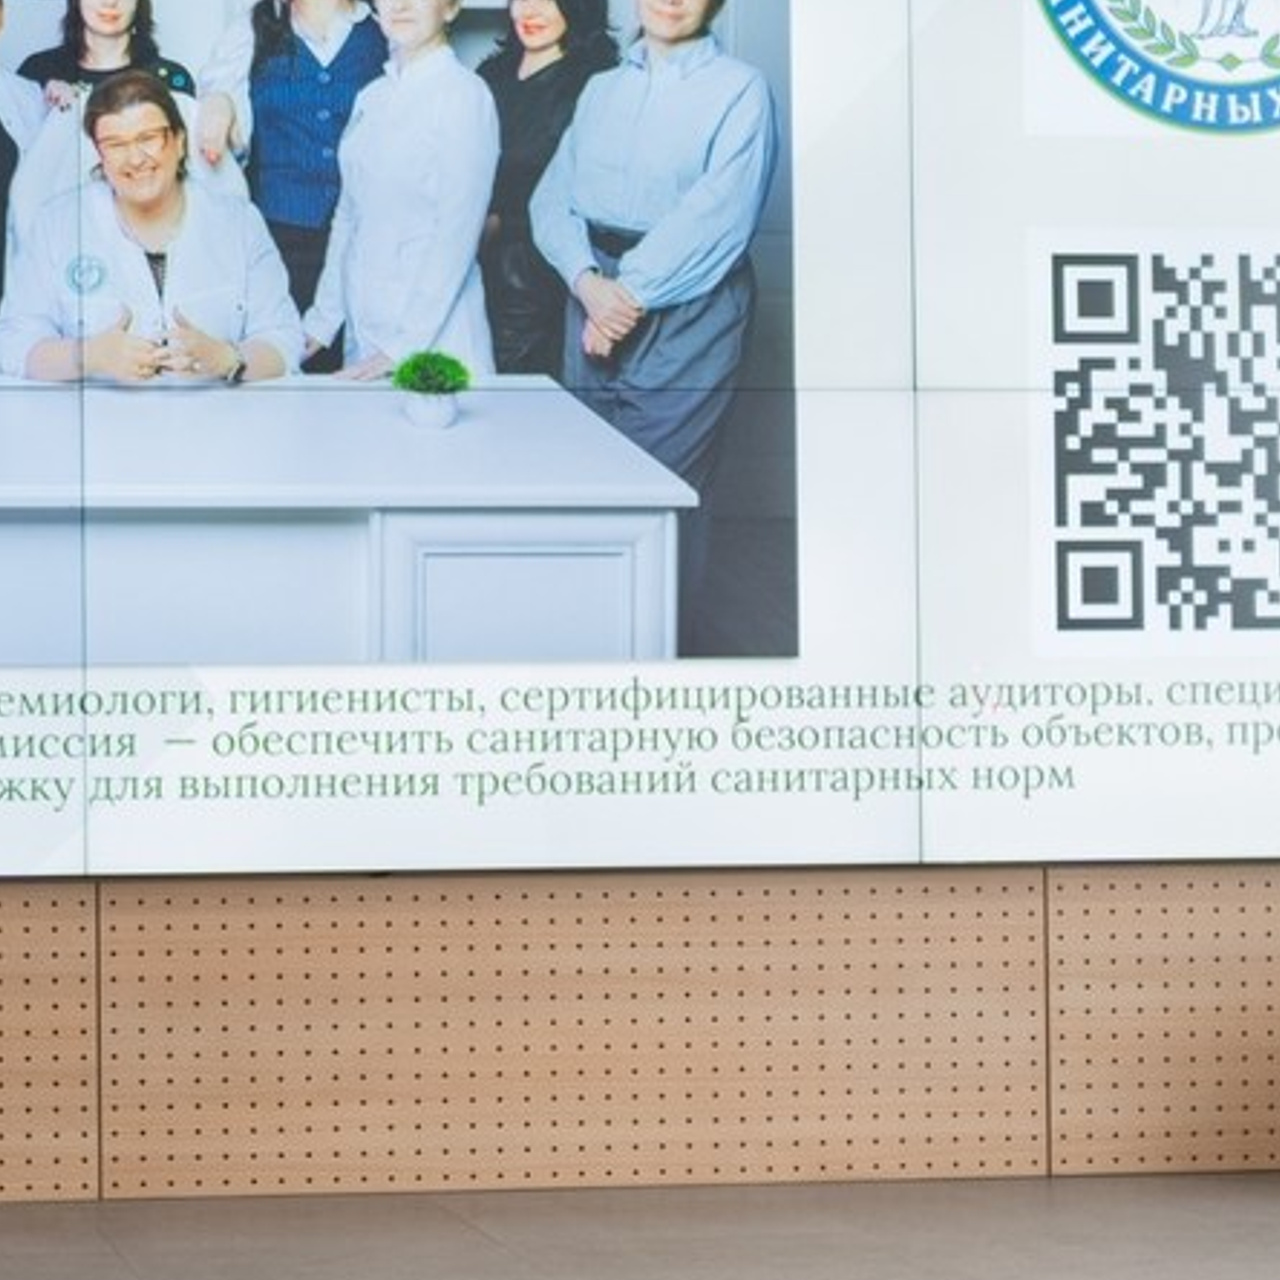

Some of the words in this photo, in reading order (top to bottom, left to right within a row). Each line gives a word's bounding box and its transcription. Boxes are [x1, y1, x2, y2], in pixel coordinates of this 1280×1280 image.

[230, 688, 486, 719] гигиенисты,
[499, 675, 936, 722] сертифицированные
[212, 720, 453, 758] обеспечить
[466, 727, 718, 764] санитарную
[731, 716, 1009, 751] безопасность
[1021, 712, 1214, 751] объектов,
[1227, 721, 1280, 756] пр
[89, 776, 164, 806] для
[179, 773, 440, 801] выполнения
[452, 760, 697, 807] требований
[711, 767, 959, 802] санитарных
[972, 765, 1076, 801] норм
